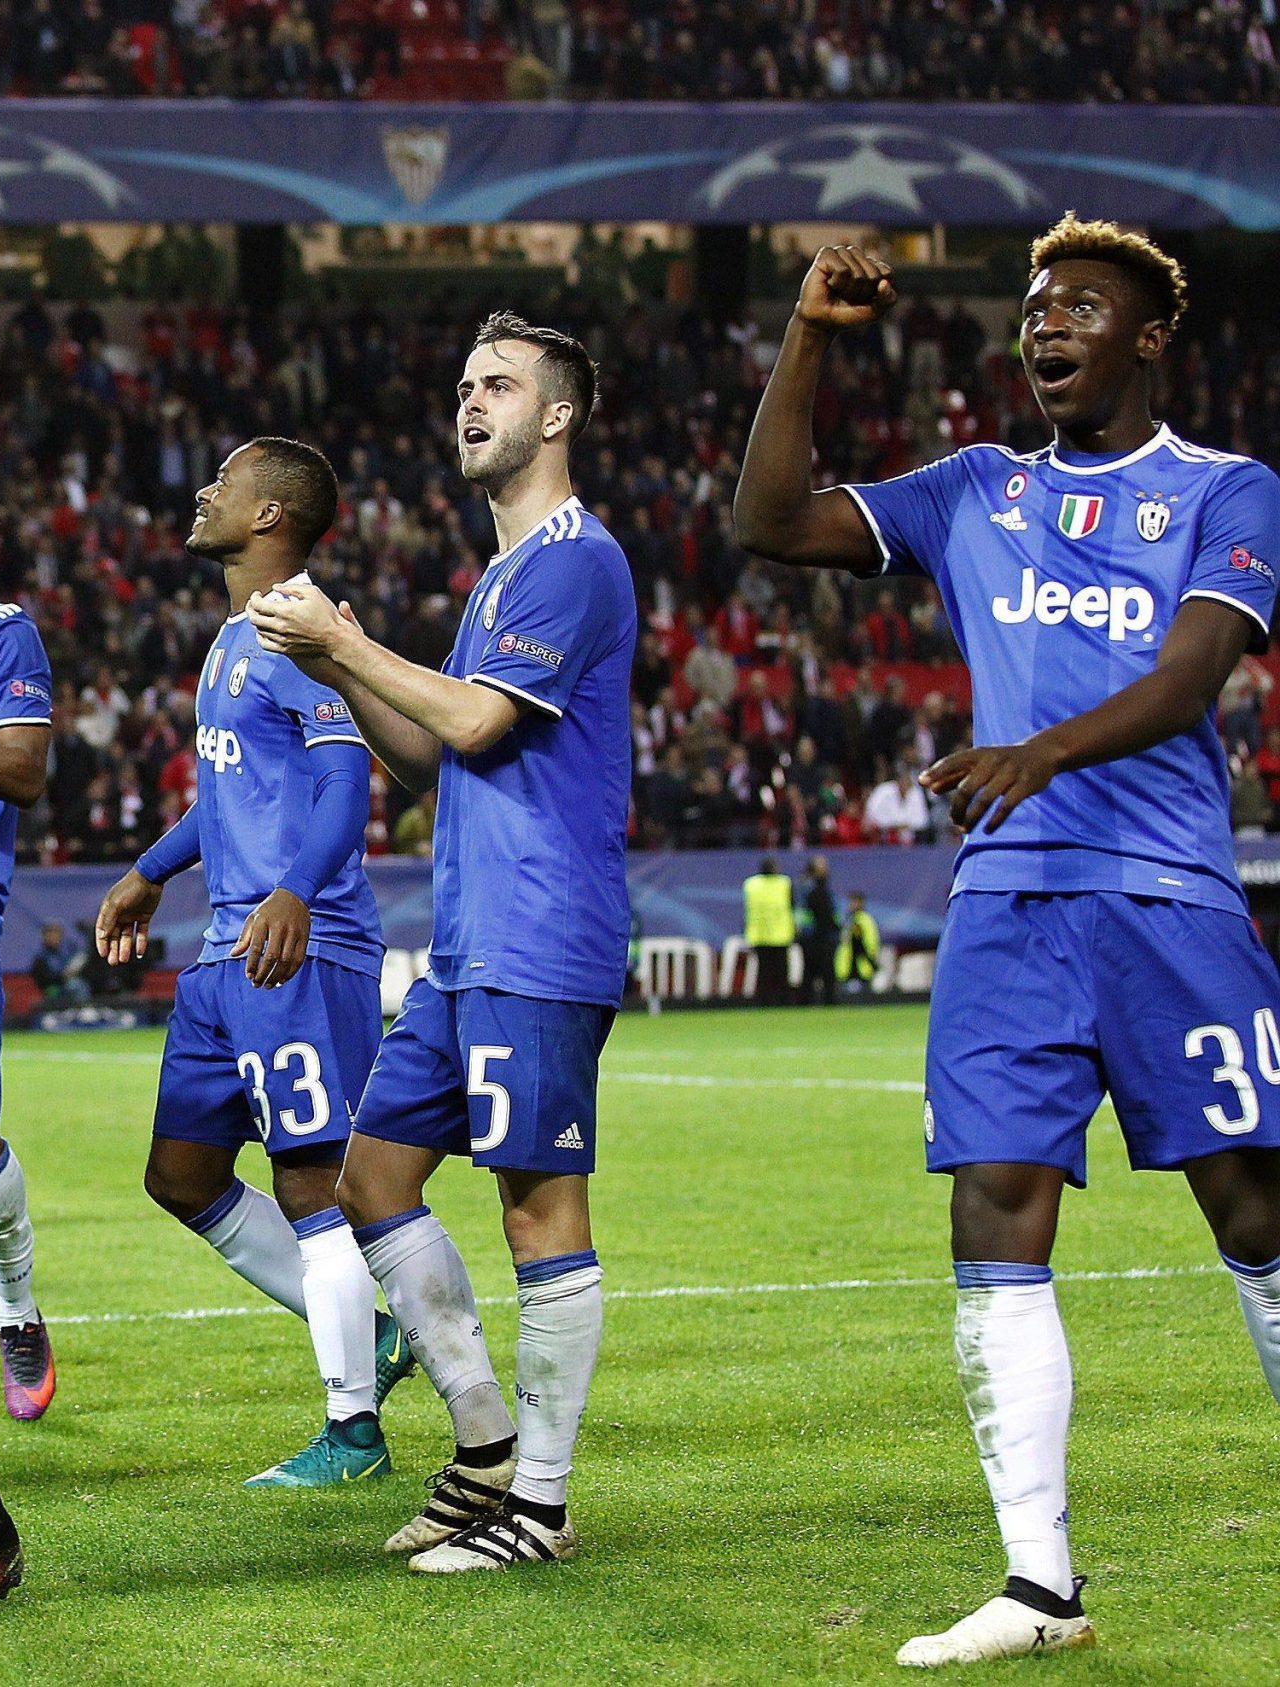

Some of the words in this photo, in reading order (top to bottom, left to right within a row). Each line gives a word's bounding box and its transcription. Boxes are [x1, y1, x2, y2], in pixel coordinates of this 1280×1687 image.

[991, 566, 1155, 642] Jeep
[515, 639, 565, 667] RESPECT
[236, 1041, 331, 1143] 33
[466, 1044, 515, 1153] 5
[1184, 1007, 1280, 1136] 34
[554, 1138, 585, 1150] adidas
